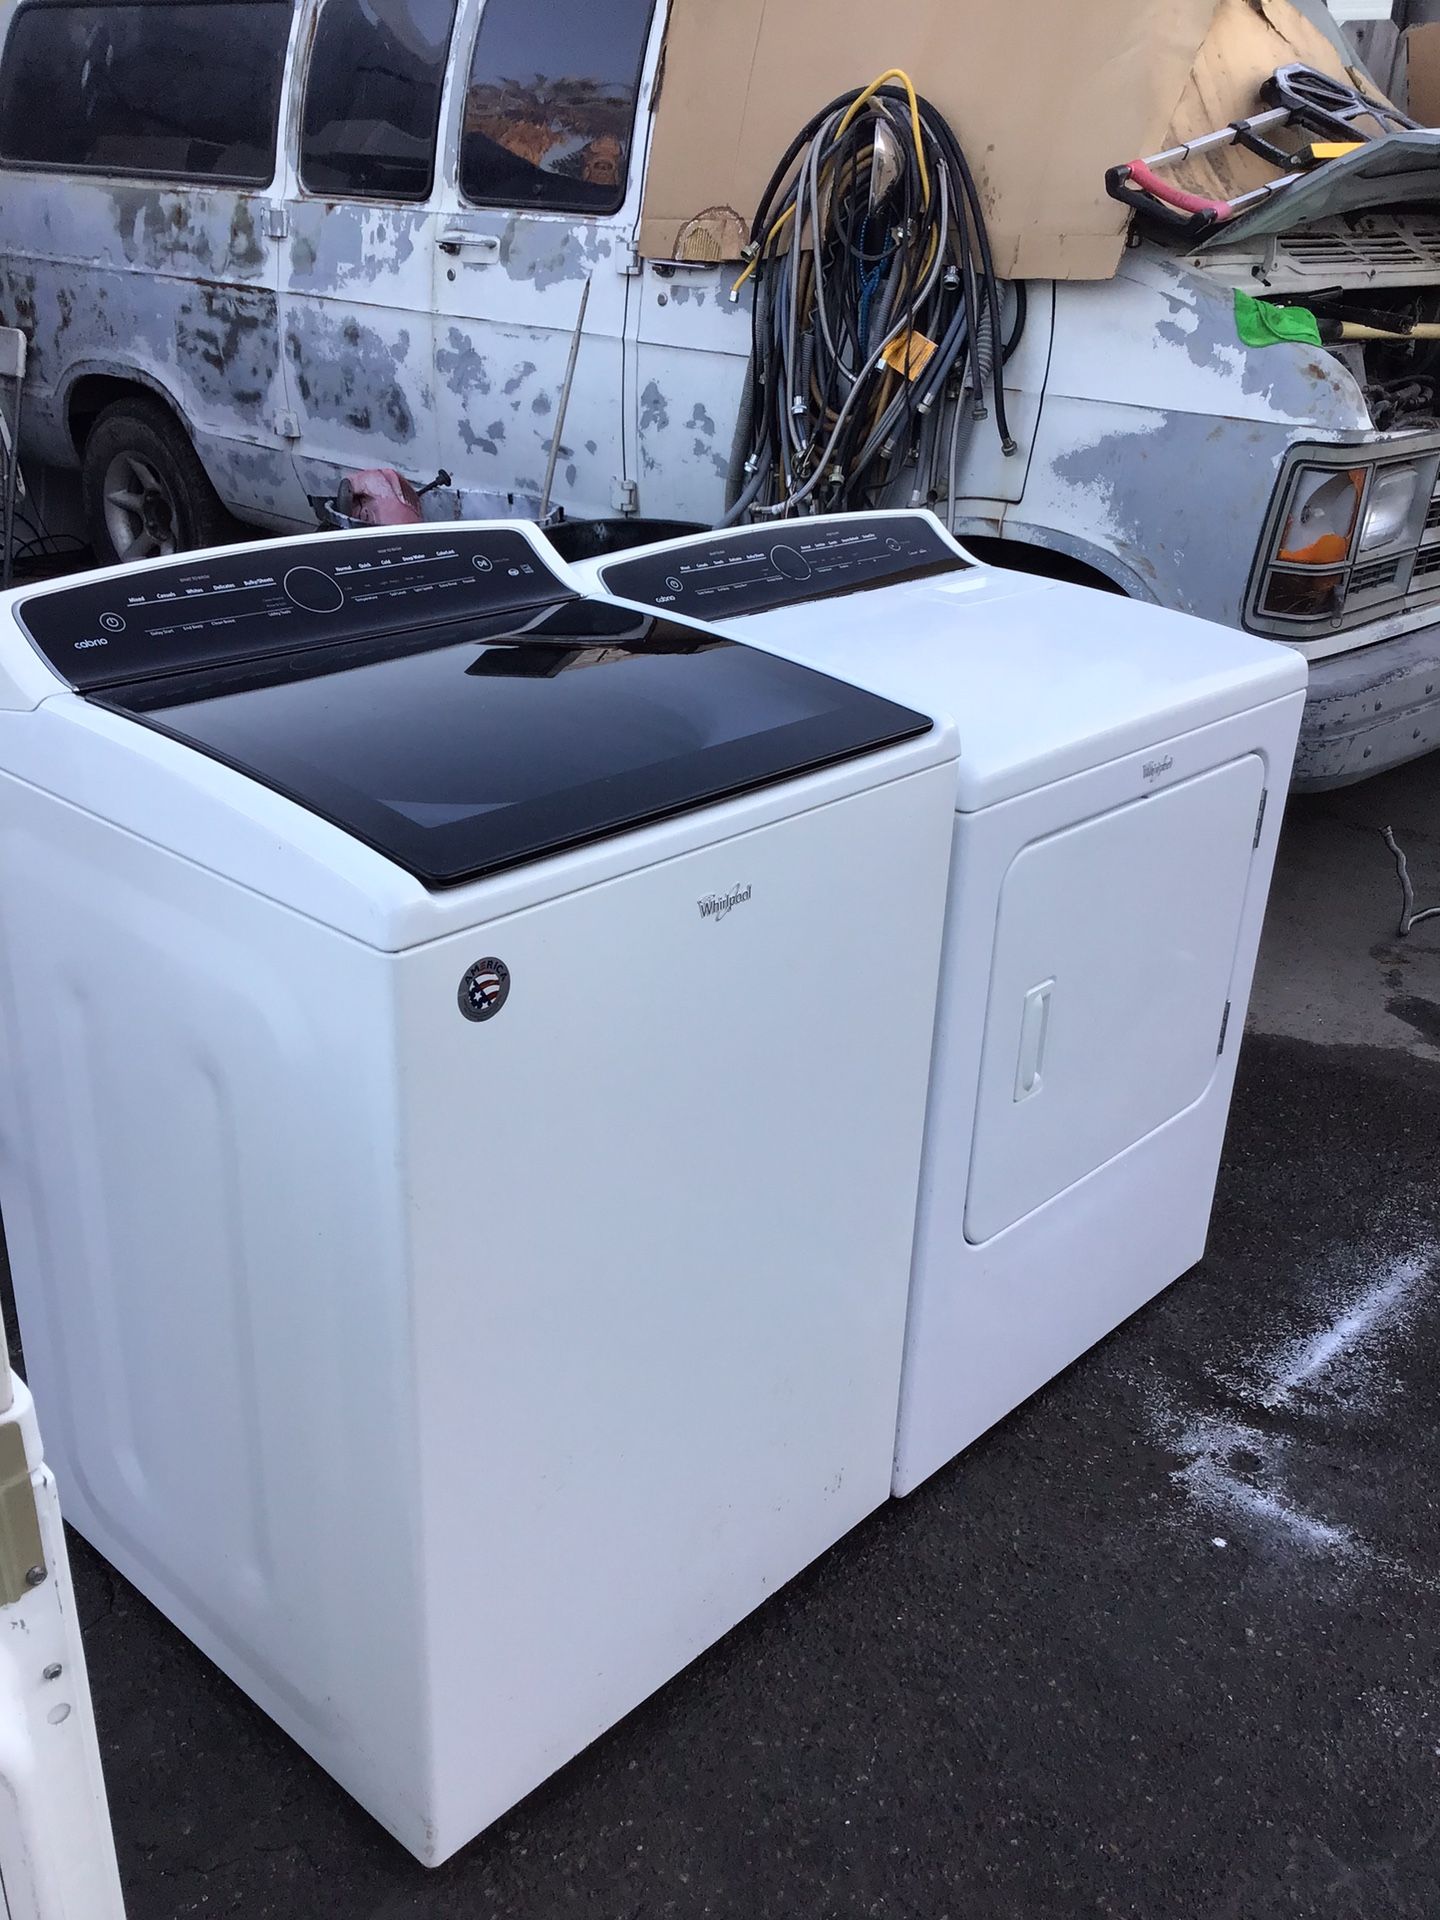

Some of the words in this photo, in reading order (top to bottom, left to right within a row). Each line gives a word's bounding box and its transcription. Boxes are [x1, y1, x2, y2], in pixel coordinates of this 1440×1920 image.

[74, 638, 108, 649] cabrio
[697, 883, 752, 921] Whirlpool
[465, 960, 507, 984] AMERICA
